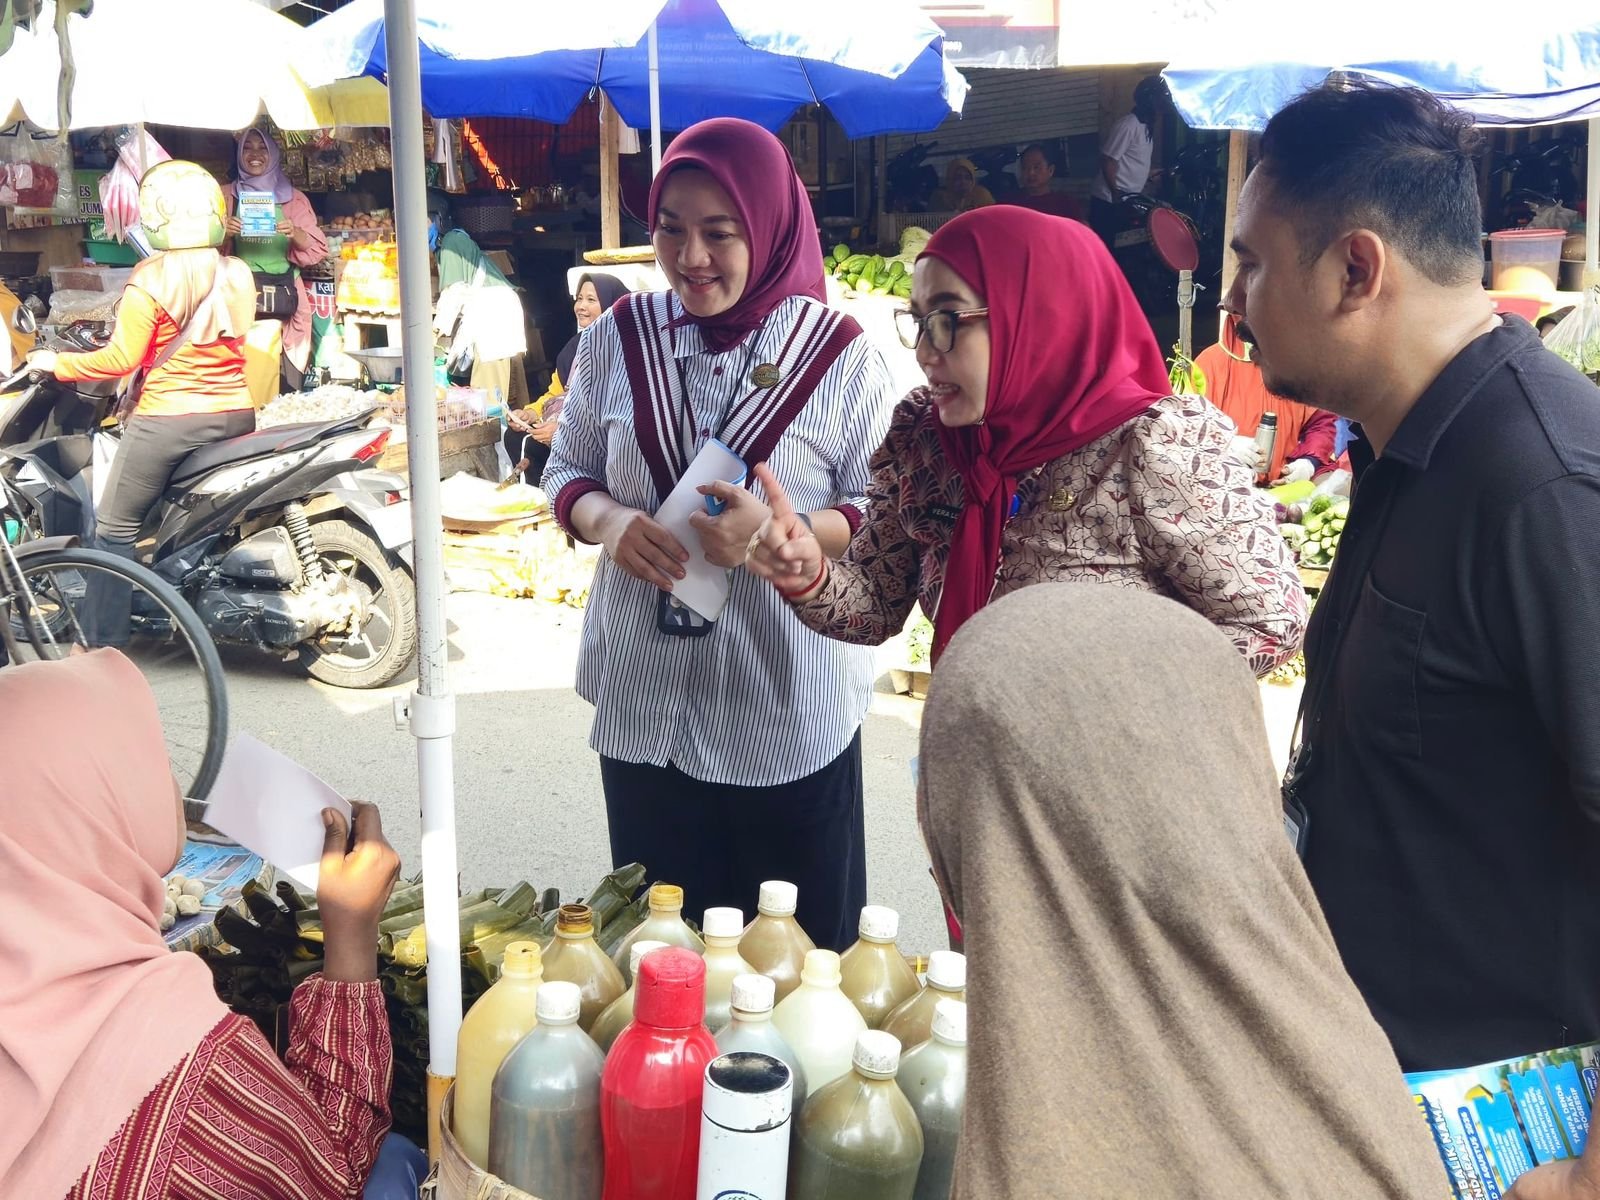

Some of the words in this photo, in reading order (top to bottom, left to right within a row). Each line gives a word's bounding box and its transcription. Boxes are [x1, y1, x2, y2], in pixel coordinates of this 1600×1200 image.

[79, 185, 91, 198] ES
[1553, 1083, 1570, 1114] DENDA
[1564, 1094, 1581, 1123] PAJAK
[1565, 1114, 1580, 1144] TANPA
[1445, 1144, 1469, 1190] BALIK
[1469, 1136, 1491, 1179] AGUSTUS
[1486, 1179, 1495, 1190] 31
